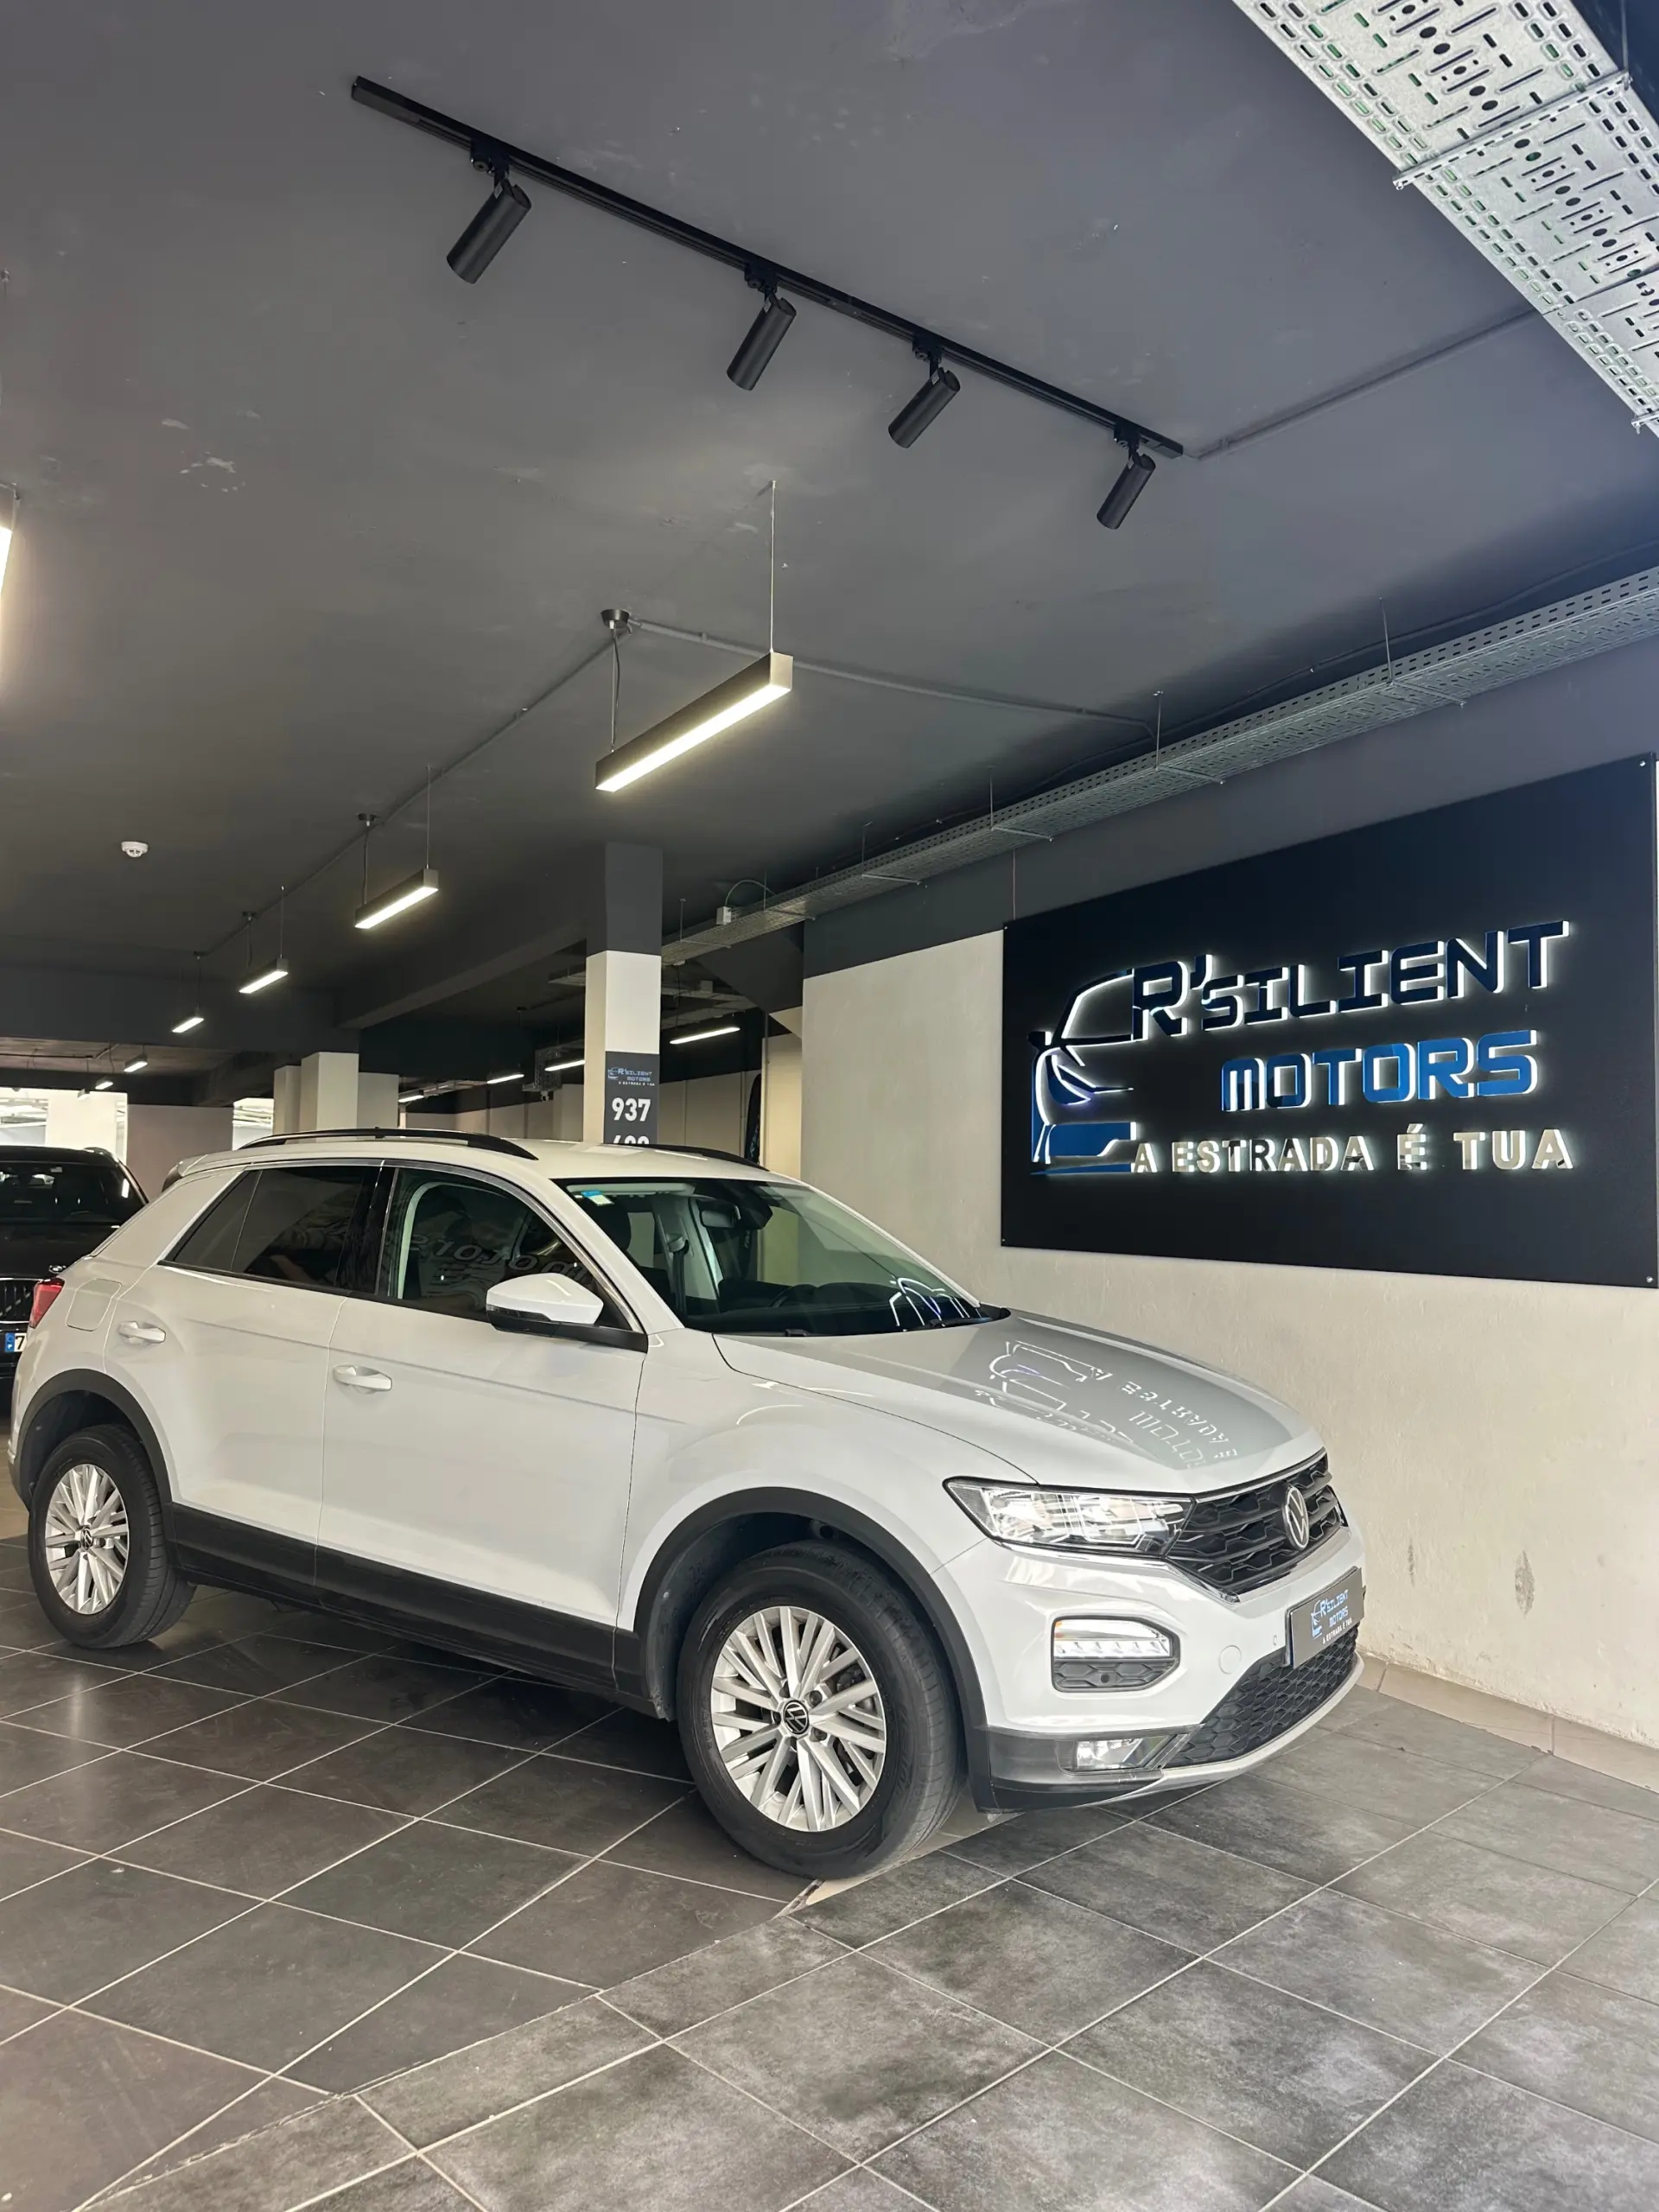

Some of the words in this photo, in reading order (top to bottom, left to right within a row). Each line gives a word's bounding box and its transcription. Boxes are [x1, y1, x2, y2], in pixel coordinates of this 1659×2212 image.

[1132, 920, 1570, 1042] R'SILIENT
[1221, 1029, 1538, 1112] MOTORS
[612, 1097, 651, 1122] 937
[1132, 1142, 1158, 1173] A
[1171, 1135, 1376, 1173] ESTRADA
[1397, 1123, 1428, 1171] É
[1452, 1128, 1574, 1171] TUA
[16, 1335, 25, 1350] 7
